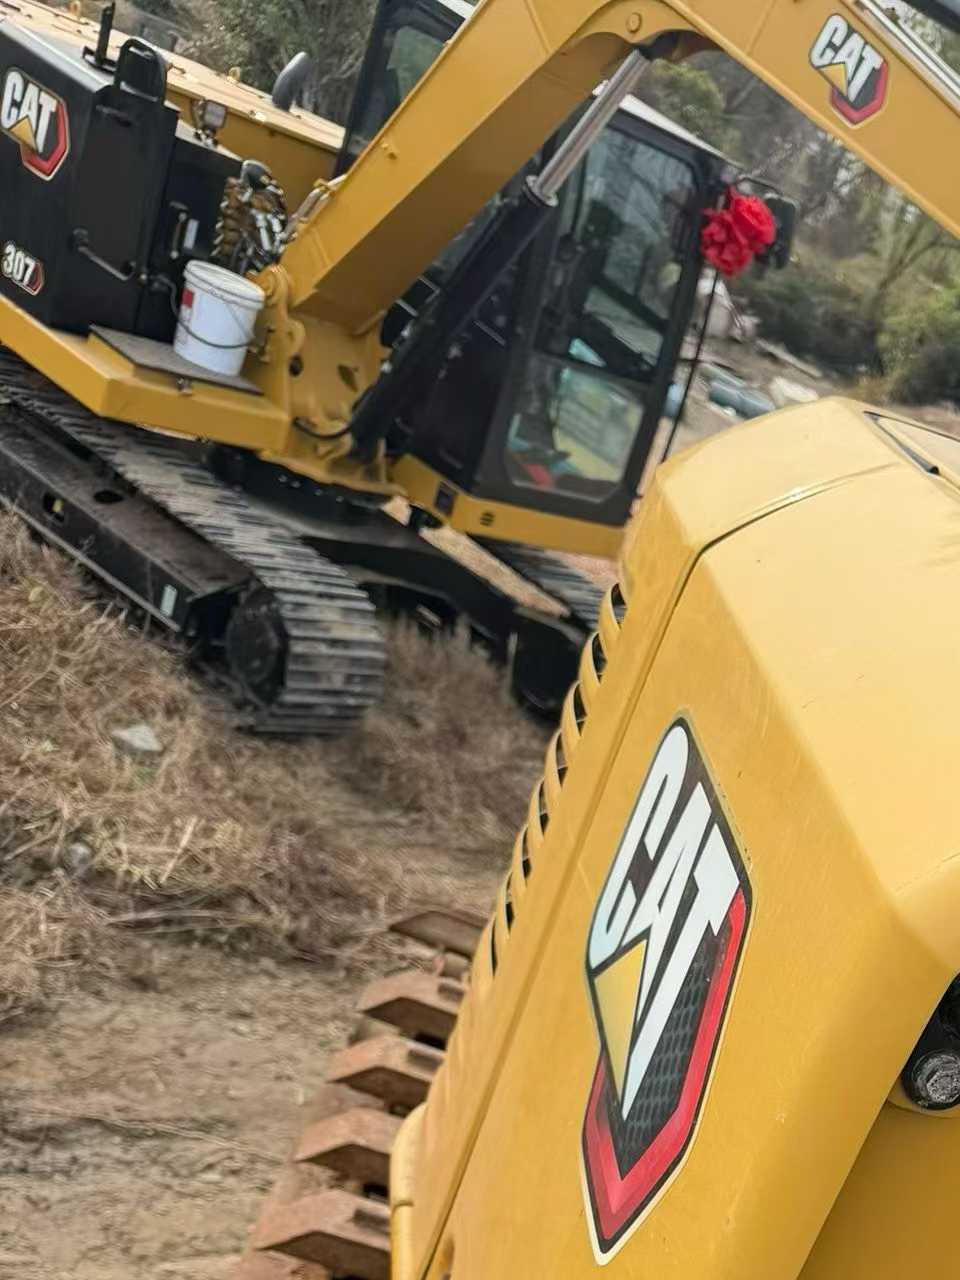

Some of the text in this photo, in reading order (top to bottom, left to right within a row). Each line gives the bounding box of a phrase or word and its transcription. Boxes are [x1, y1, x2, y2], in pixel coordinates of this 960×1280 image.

[811, 14, 884, 103] CAT
[0, 69, 59, 153] CAT
[1, 243, 35, 287] 307
[587, 724, 740, 1121] CAT
